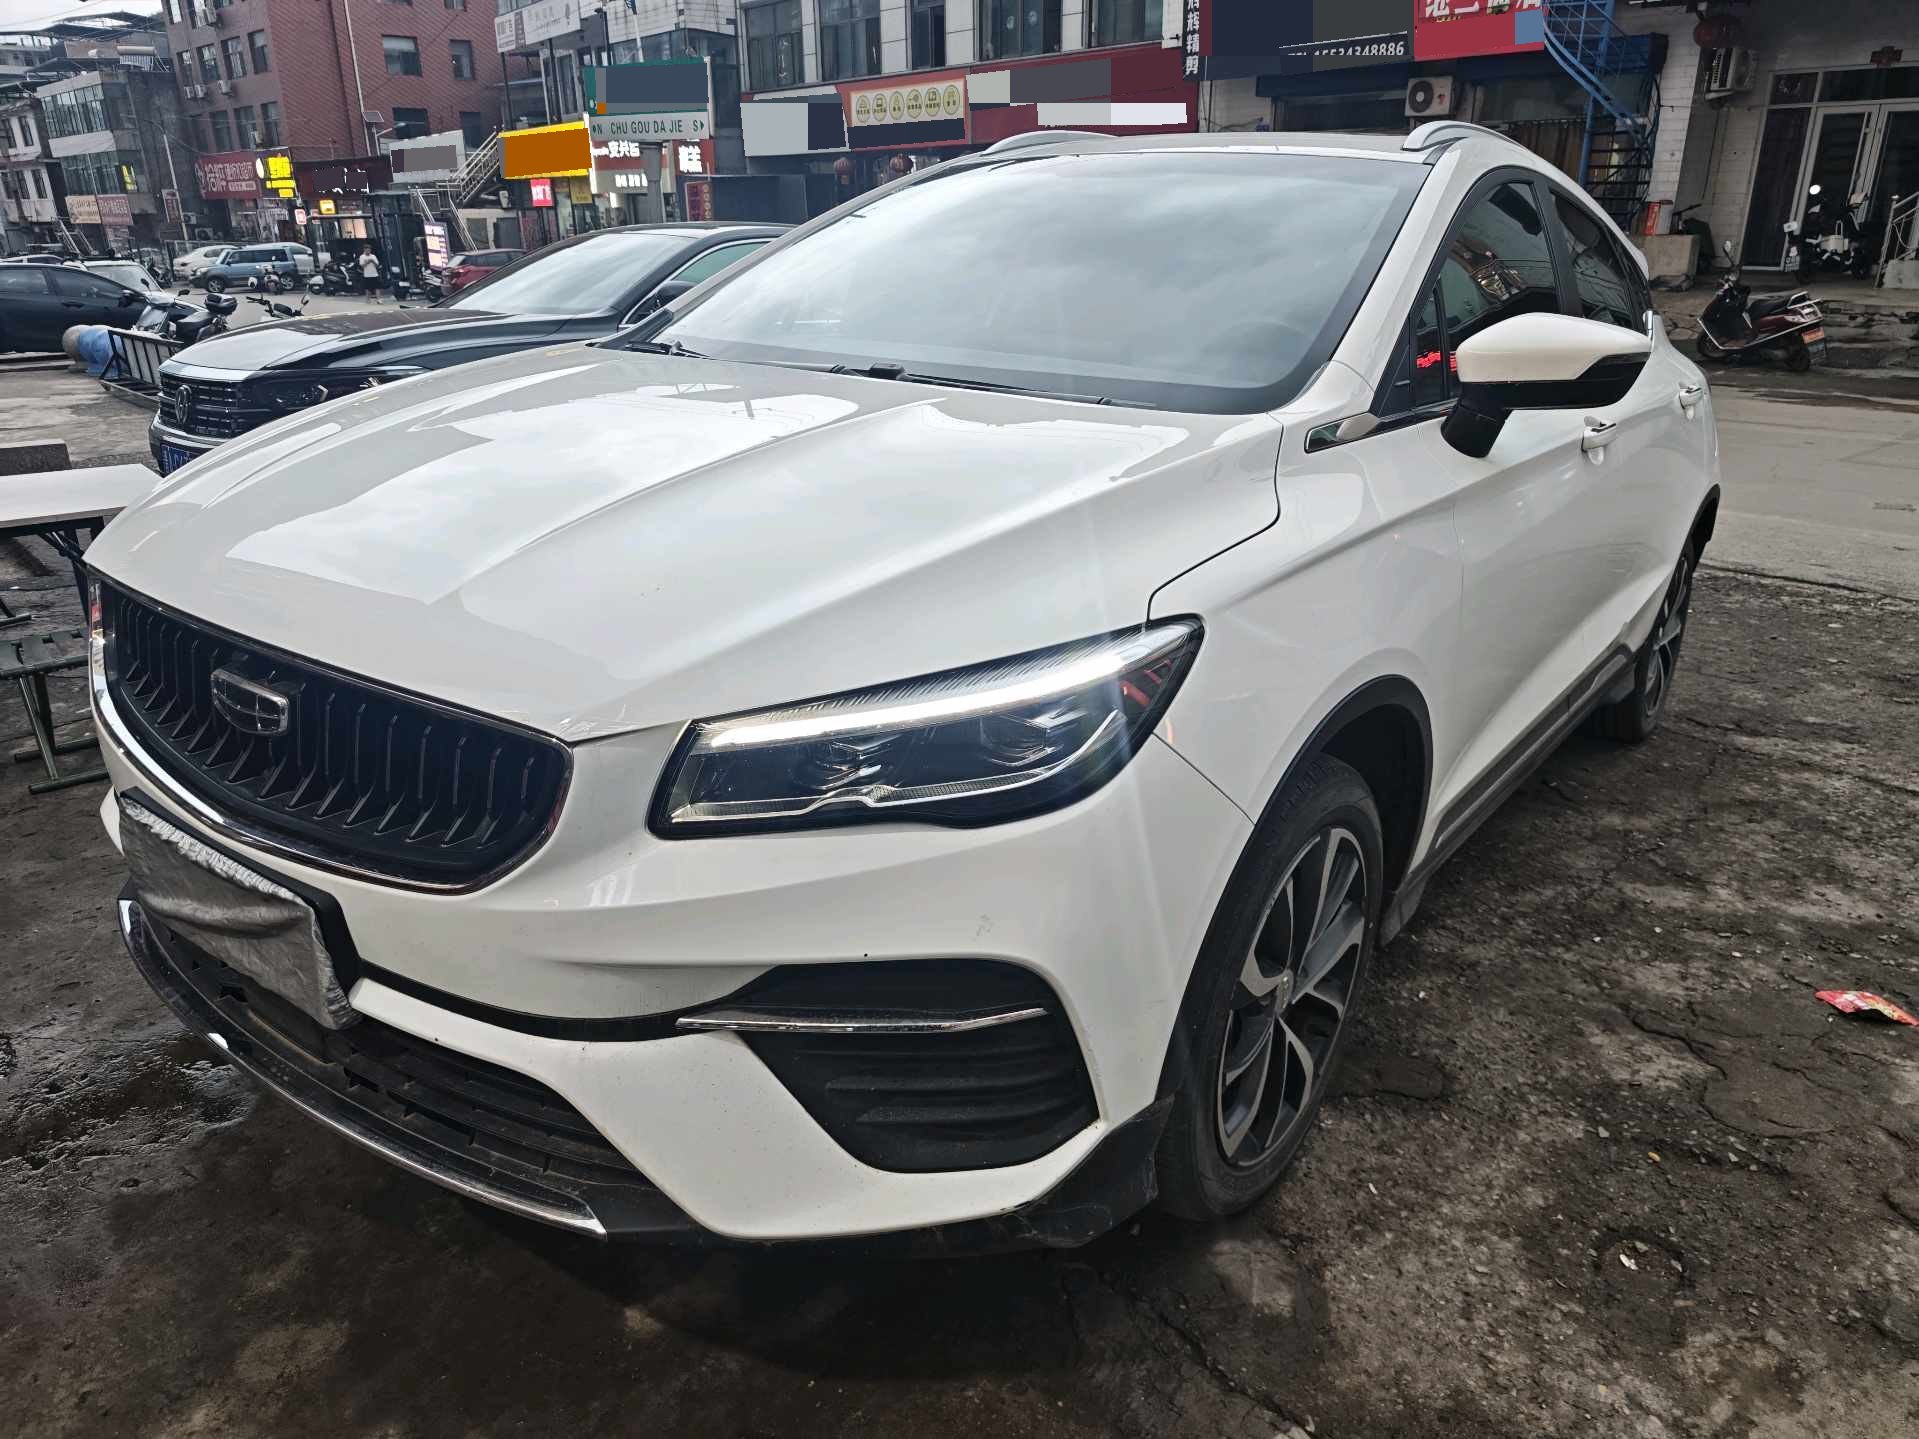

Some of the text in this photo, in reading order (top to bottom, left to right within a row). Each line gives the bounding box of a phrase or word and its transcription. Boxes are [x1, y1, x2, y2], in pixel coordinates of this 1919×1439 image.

[1314, 41, 1404, 55] 4348886
[610, 121, 628, 135] CHU
[631, 120, 650, 134] GOU
[653, 119, 666, 134] DA
[669, 119, 683, 134] JIE
[693, 119, 699, 132] S
